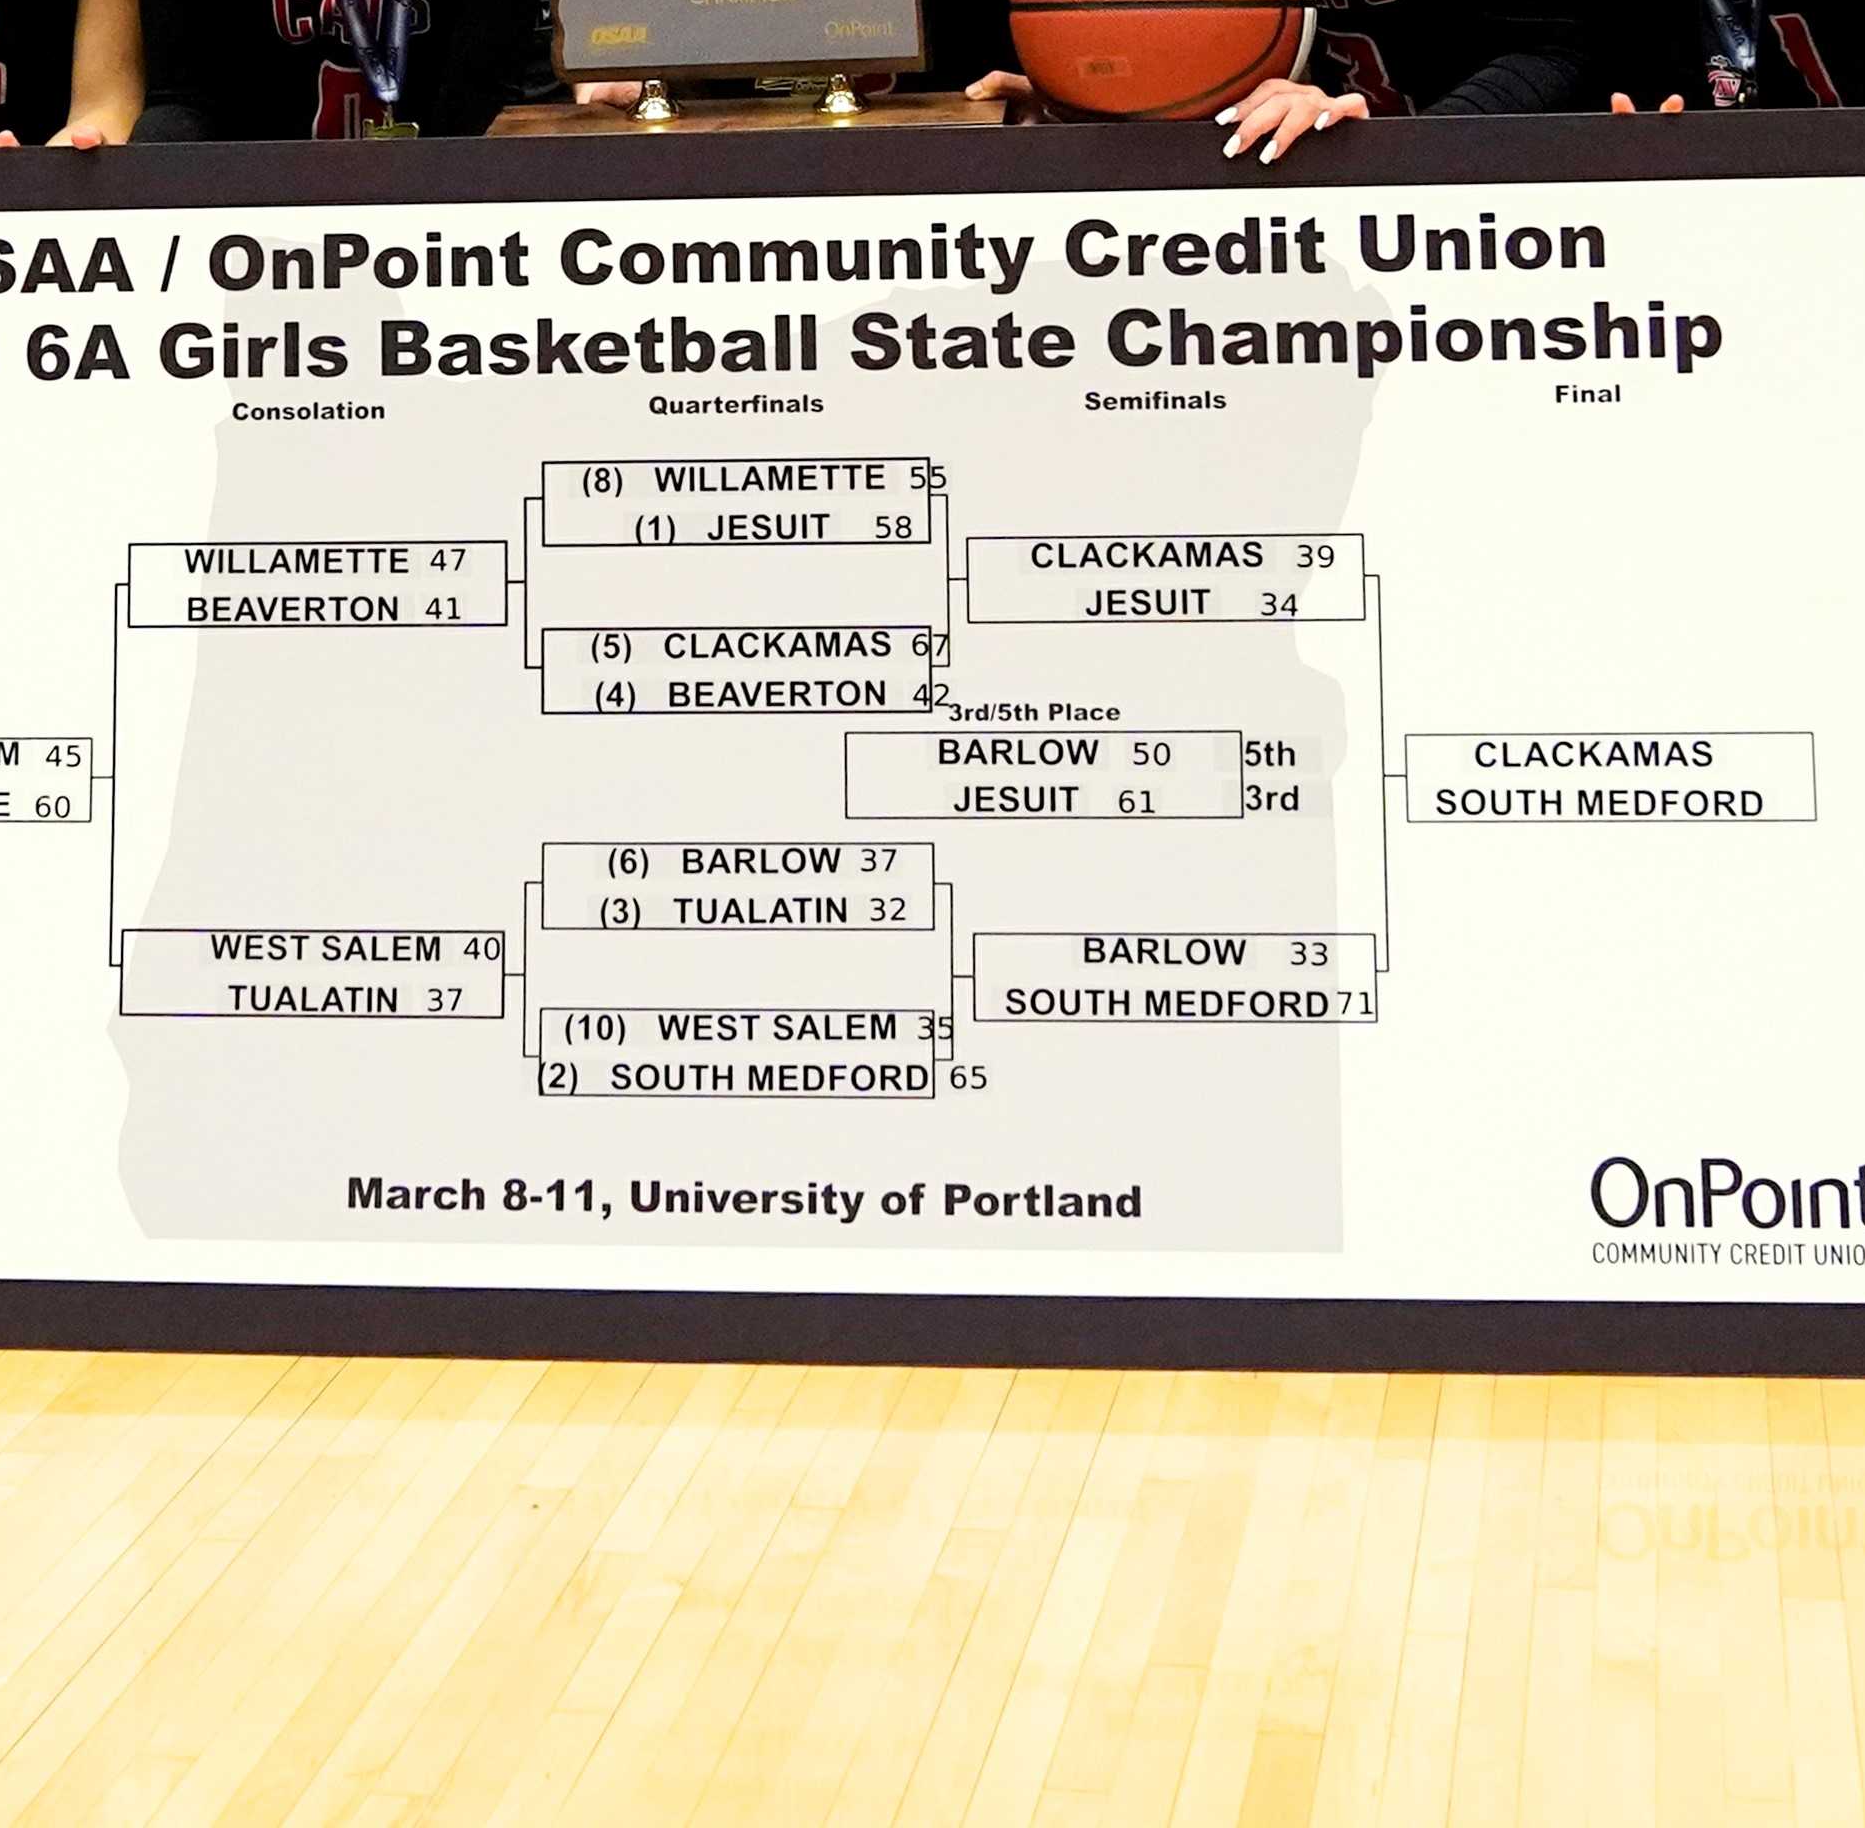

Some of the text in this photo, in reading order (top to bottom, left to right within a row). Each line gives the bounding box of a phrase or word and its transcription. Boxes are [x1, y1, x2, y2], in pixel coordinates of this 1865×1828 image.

[161, 236, 180, 292] /
[210, 232, 529, 291] OnPoint
[561, 223, 1034, 294] Community
[1066, 217, 1325, 277] Credit
[1360, 214, 1605, 272] Union
[27, 325, 130, 380] 6A
[160, 322, 348, 379] Girls
[381, 315, 816, 376] Basketball
[851, 312, 1075, 370] State
[1108, 301, 1721, 378] Championship
[650, 395, 823, 415] Quarterfinals
[1086, 391, 1226, 410] Semifinals
[1556, 385, 1620, 403] Final
[233, 402, 384, 420] Consolation
[583, 465, 947, 497] (8) WILLAMETTE 55
[635, 514, 911, 545] (1) JESUIT 58
[185, 549, 465, 573] WILLAMETTE 47
[1032, 542, 1334, 568] CLACKAMAS 39
[188, 597, 460, 621] BEAVERTON 41
[1086, 589, 1297, 616] JESUIT 34
[592, 631, 949, 663] (5) CLACKAMAS 67
[594, 680, 950, 712] (4) BEAVERTON 42
[949, 703, 1120, 721] 3rd/5th Place
[46, 745, 80, 767] 45
[939, 739, 1170, 766] BARLOW 50
[1245, 741, 1295, 766] 5th
[1476, 741, 1712, 767] CLACKAMAS
[36, 796, 70, 818] 60
[954, 786, 1154, 813] JESUIT 61
[1246, 785, 1298, 811] 3rd
[1437, 789, 1762, 816] SOUTH MEDFORD
[609, 848, 896, 879] (6) BARLOW 37
[600, 897, 905, 929] (3) TUALATIN 32
[211, 935, 501, 961] WEST SALEM 40
[1085, 938, 1327, 966] BARLOW 33
[229, 985, 462, 1012] TUALATIN 37
[1006, 989, 1373, 1017] SOUTH MEDFORD 71
[566, 1014, 954, 1045] (10) WEST SALEM 35
[538, 1063, 986, 1095] (2) SOUTH MEDFORD 65
[349, 1178, 1140, 1223] March 8-11, University of Portland
[1593, 1244, 1718, 1264] COMMUNITY
[1731, 1244, 1802, 1264] CREDIT
